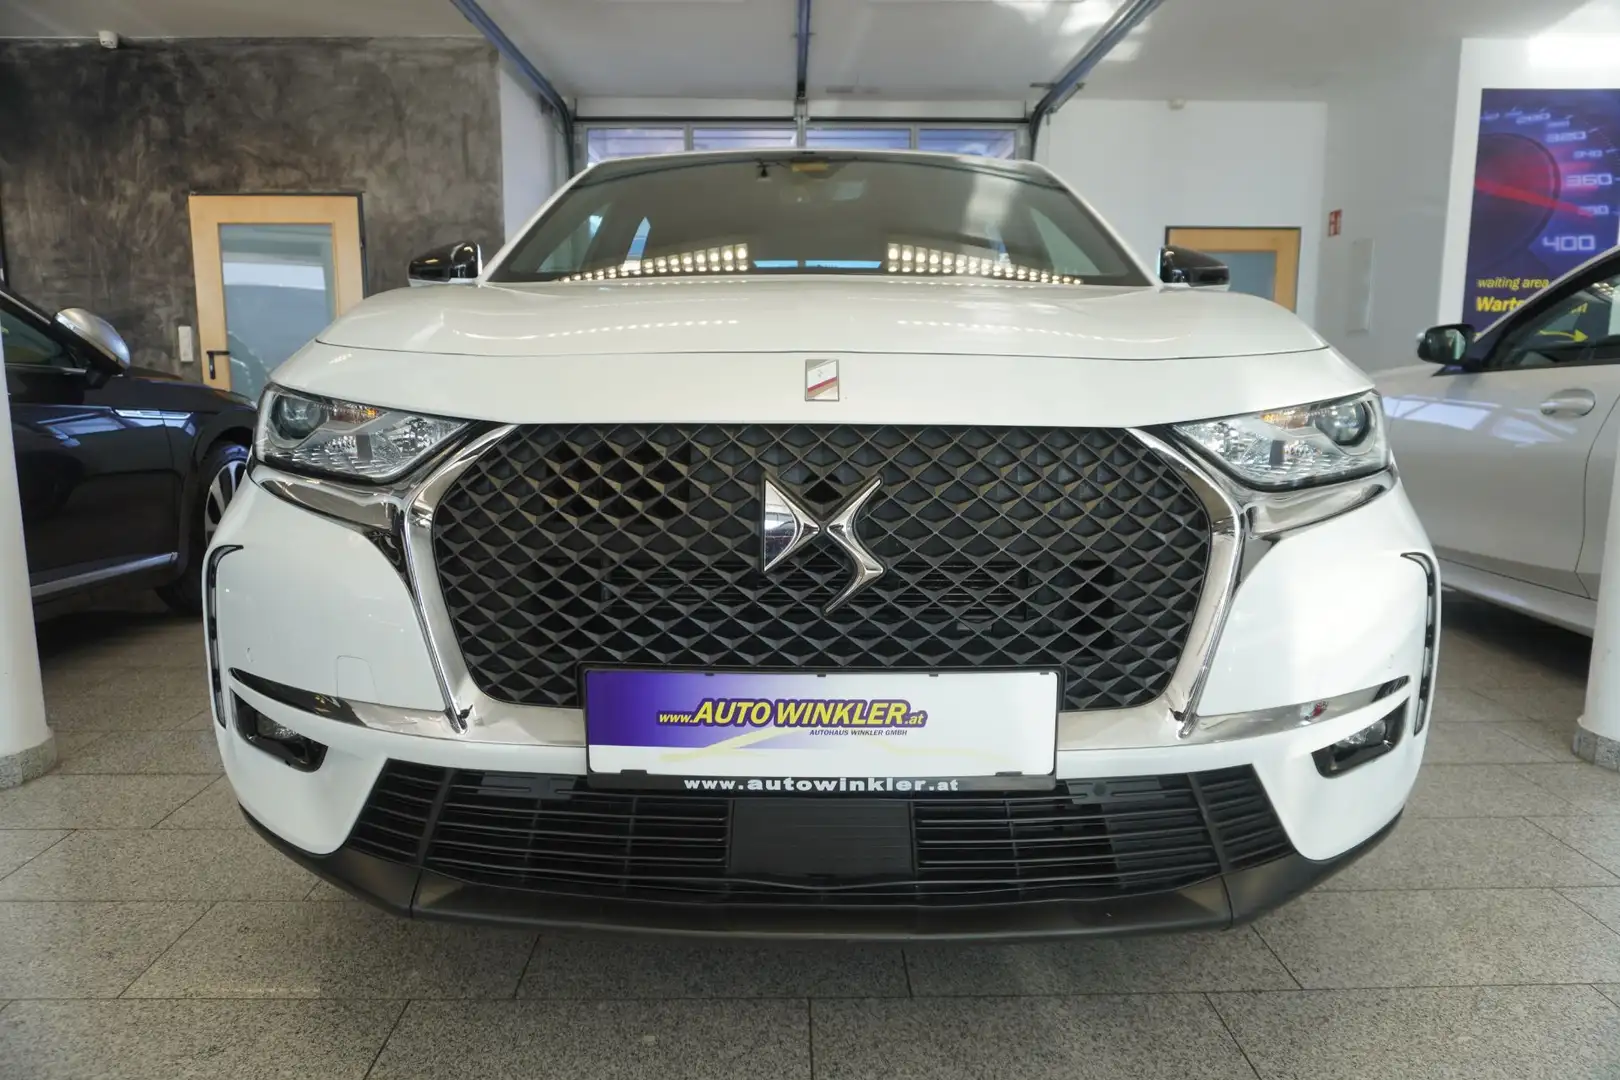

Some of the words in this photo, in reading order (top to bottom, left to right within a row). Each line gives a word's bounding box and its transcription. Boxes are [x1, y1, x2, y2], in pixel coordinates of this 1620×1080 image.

[1565, 173, 1612, 187] 360
[1542, 235, 1596, 251] 400
[1477, 277, 1520, 291] waiting
[1522, 280, 1550, 290] area
[684, 777, 959, 791] www.autowinkler.at
